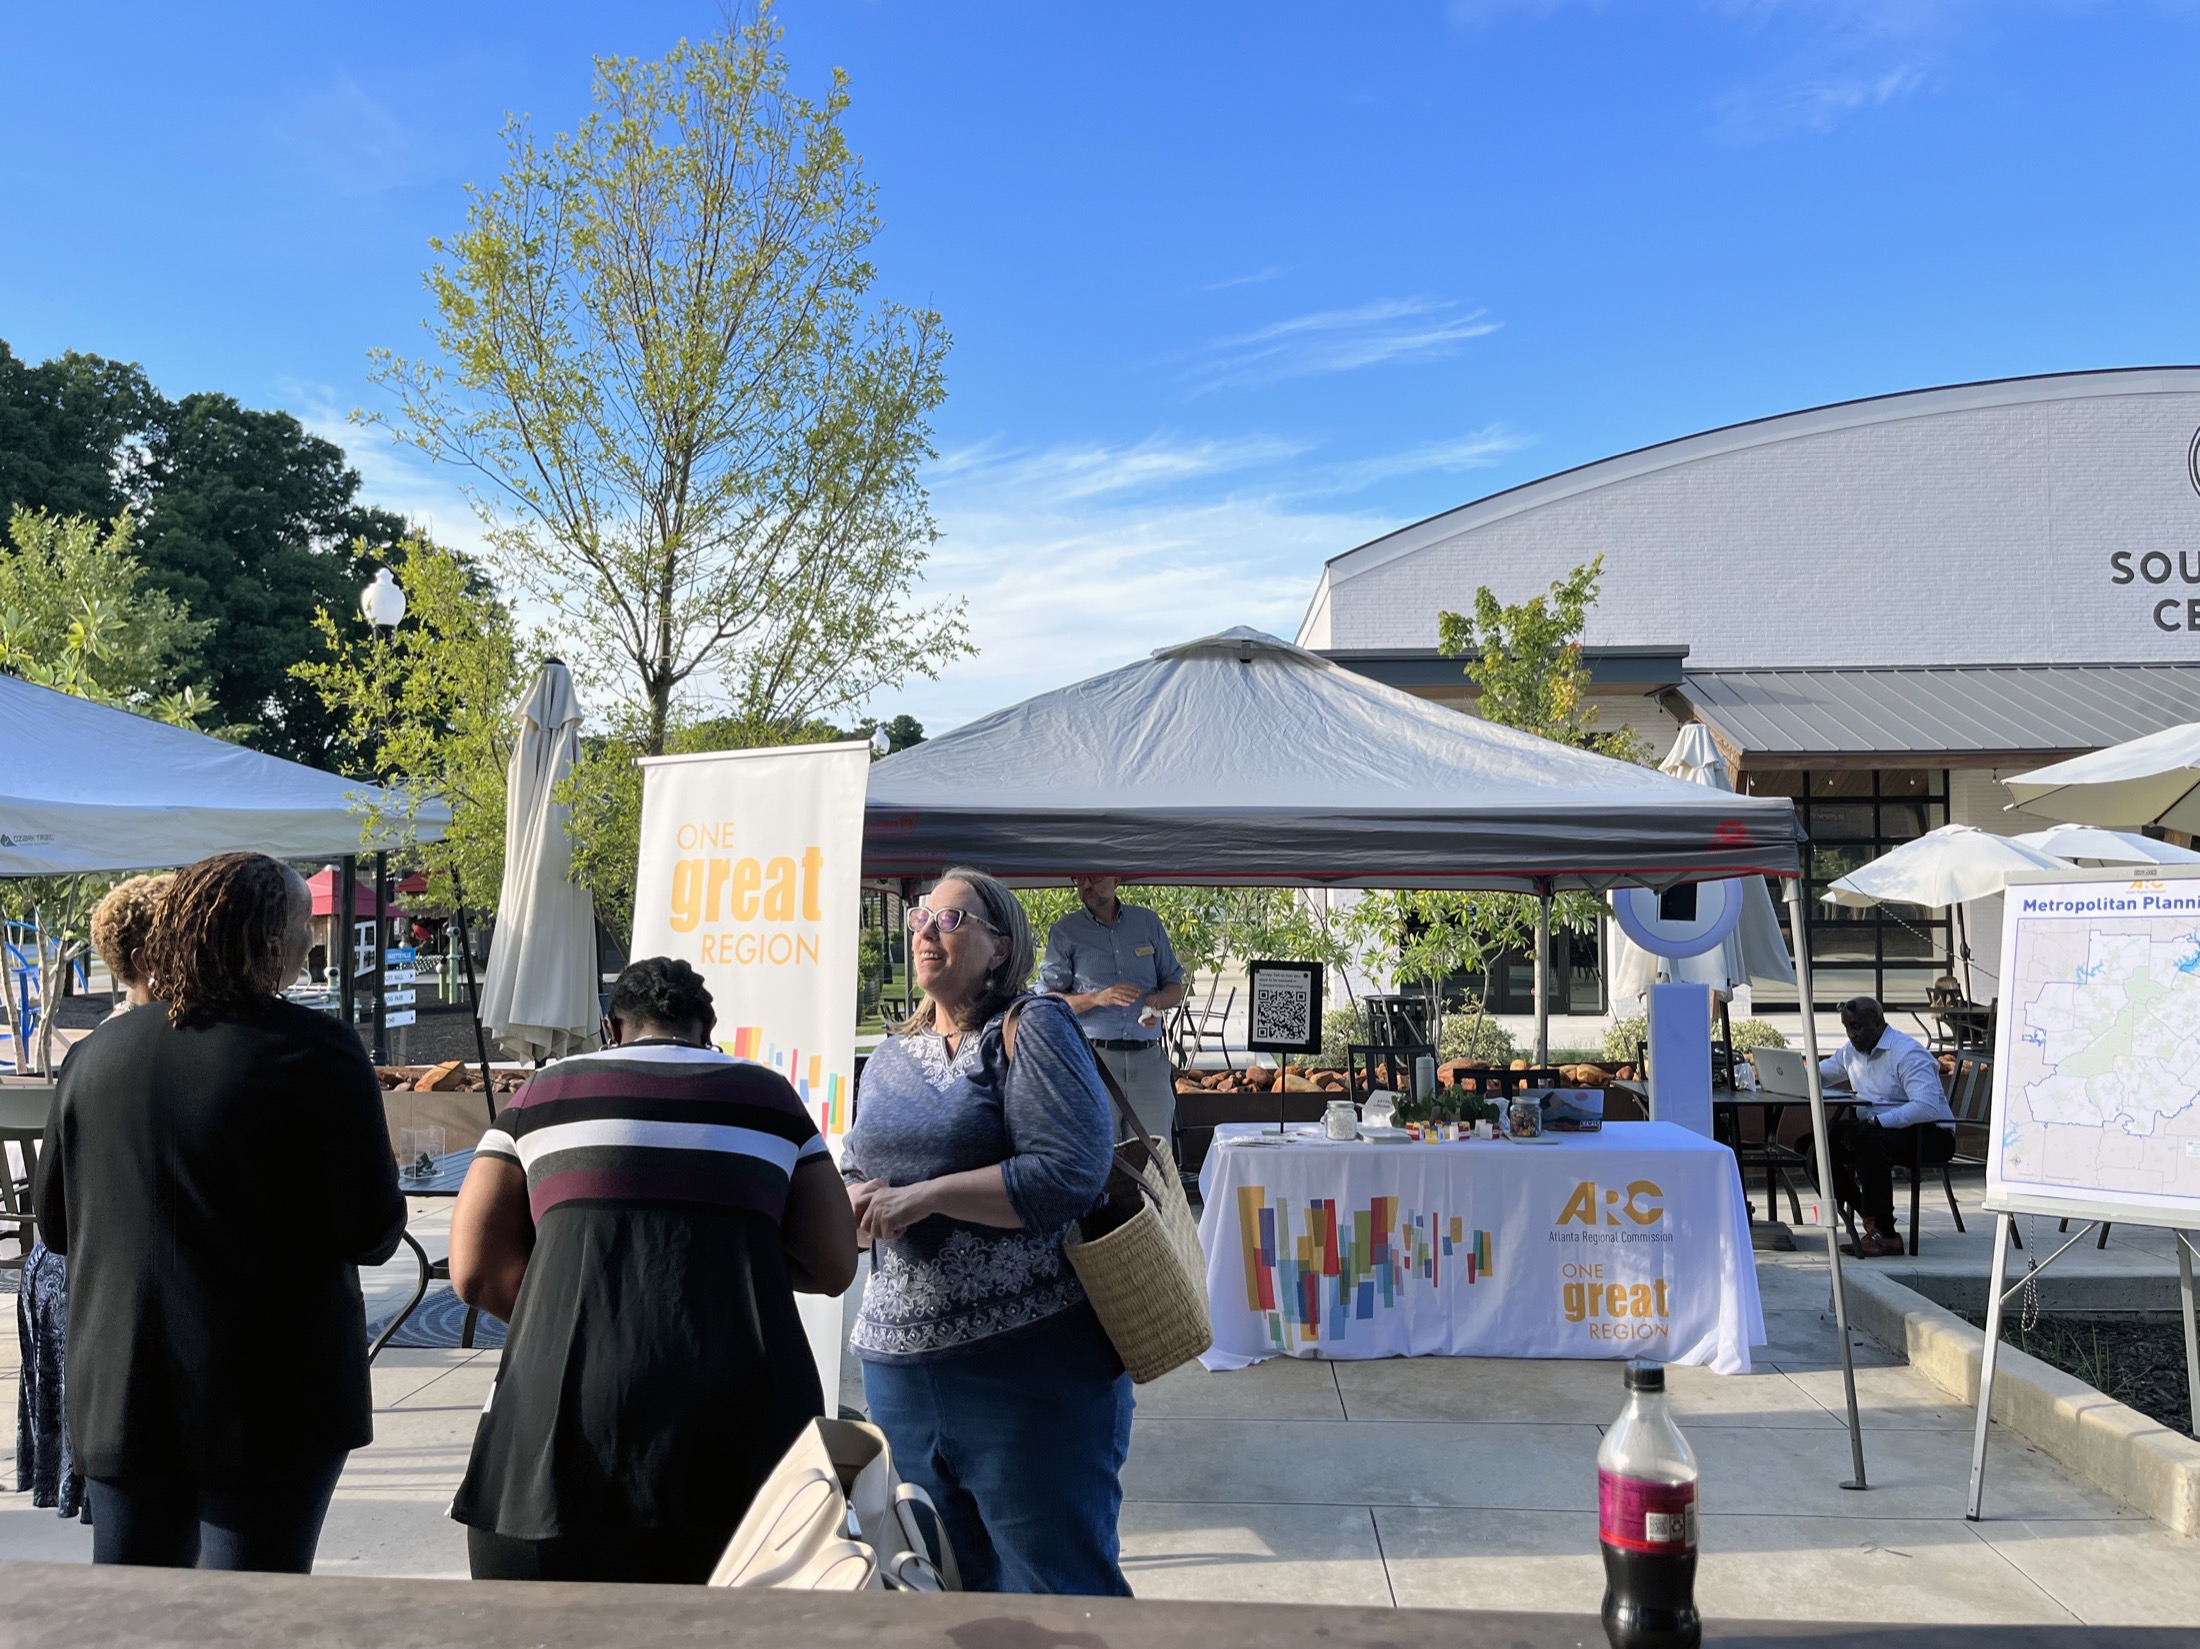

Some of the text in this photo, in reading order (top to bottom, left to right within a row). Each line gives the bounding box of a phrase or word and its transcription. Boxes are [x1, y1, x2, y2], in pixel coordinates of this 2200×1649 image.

[2110, 551, 2200, 585] SOU
[676, 821, 735, 850] ONE
[669, 846, 824, 933] great
[2022, 897, 2137, 914] Metropolitan
[701, 933, 820, 966] REGION
[1555, 1180, 1664, 1226] ARC
[1548, 1231, 1674, 1245] Atlanta Regional Commission
[1562, 1263, 1604, 1278] ONE
[1563, 1279, 1670, 1323] great
[1589, 1323, 1669, 1340] REGION
